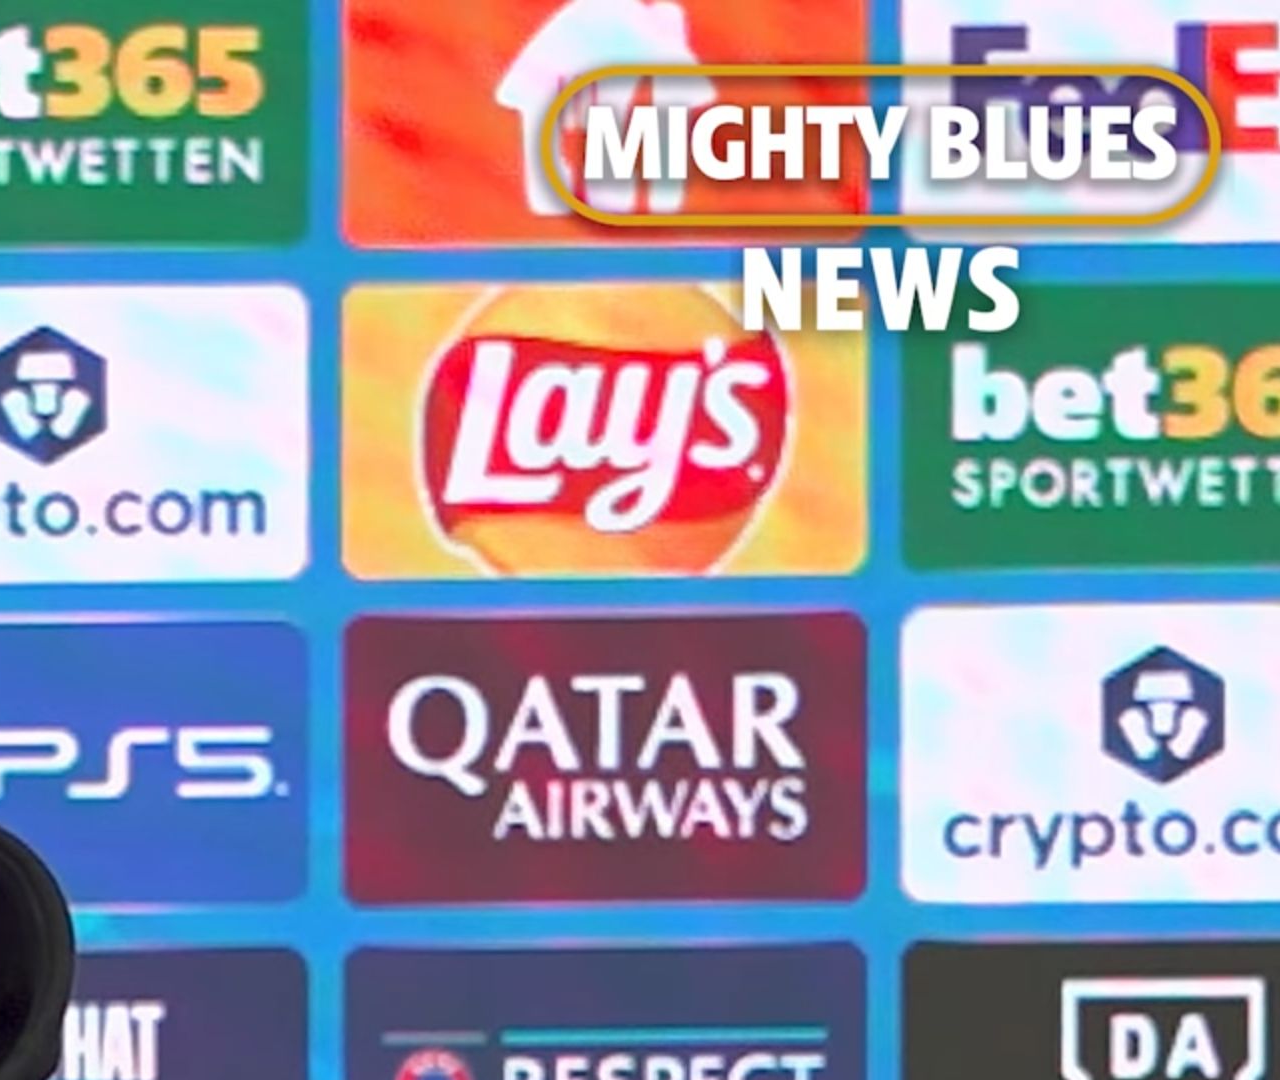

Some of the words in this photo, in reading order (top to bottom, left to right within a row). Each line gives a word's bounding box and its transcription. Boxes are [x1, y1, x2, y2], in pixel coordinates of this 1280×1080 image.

[443, 337, 771, 532] Lay's
[389, 673, 804, 797] QATAR
[494, 778, 807, 839] AIRWAYS
[1111, 1014, 1219, 1078] DA
